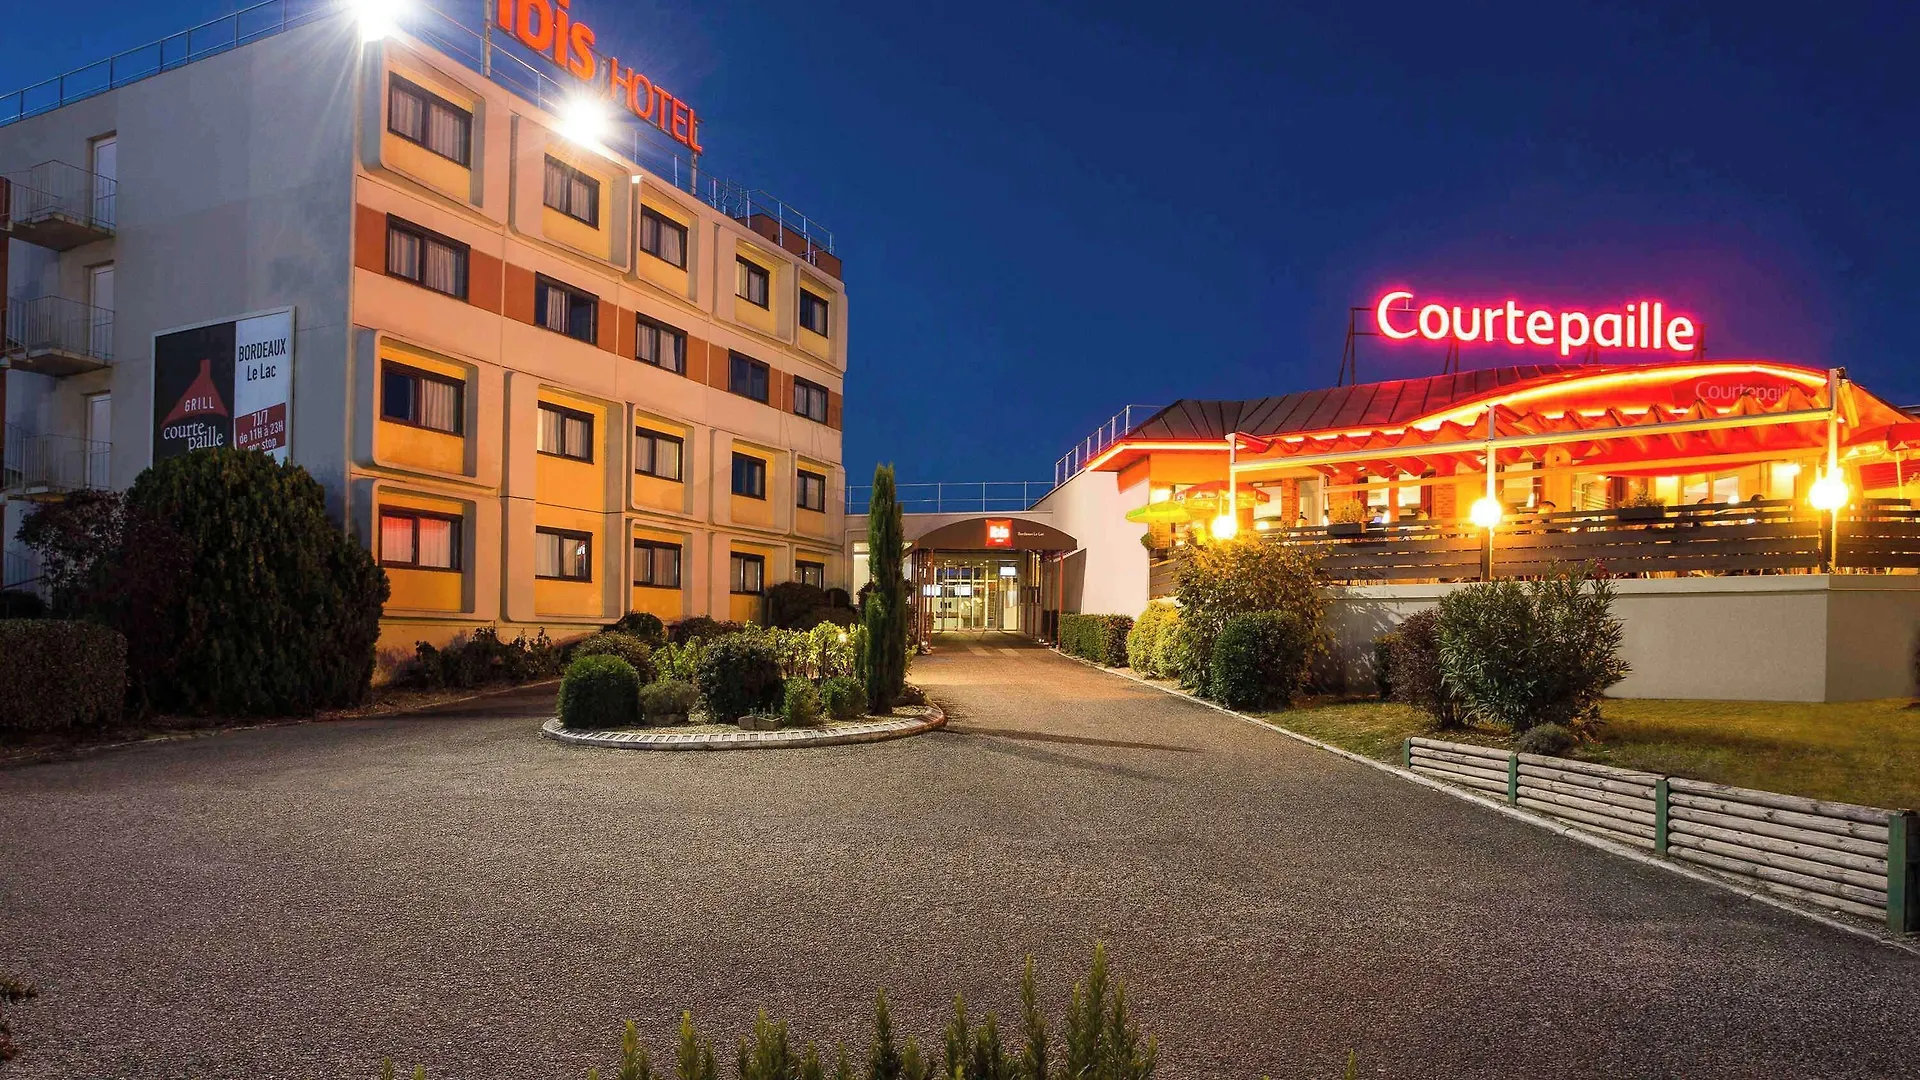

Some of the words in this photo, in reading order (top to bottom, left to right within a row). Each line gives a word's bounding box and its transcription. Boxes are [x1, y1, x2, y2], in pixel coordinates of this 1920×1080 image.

[610, 56, 702, 154] HOTEL
[1377, 291, 1695, 356] Courtepaille
[238, 338, 287, 362] BORDEAUX
[247, 365, 258, 382] Le
[260, 363, 277, 380] Lac
[184, 396, 215, 412] GRILL
[163, 422, 206, 440] courte
[188, 425, 224, 454] paille
[239, 432, 248, 444] de
[249, 426, 263, 441] 11H
[263, 425, 269, 437] à
[269, 419, 284, 435] 23H
[261, 437, 277, 450] stop
